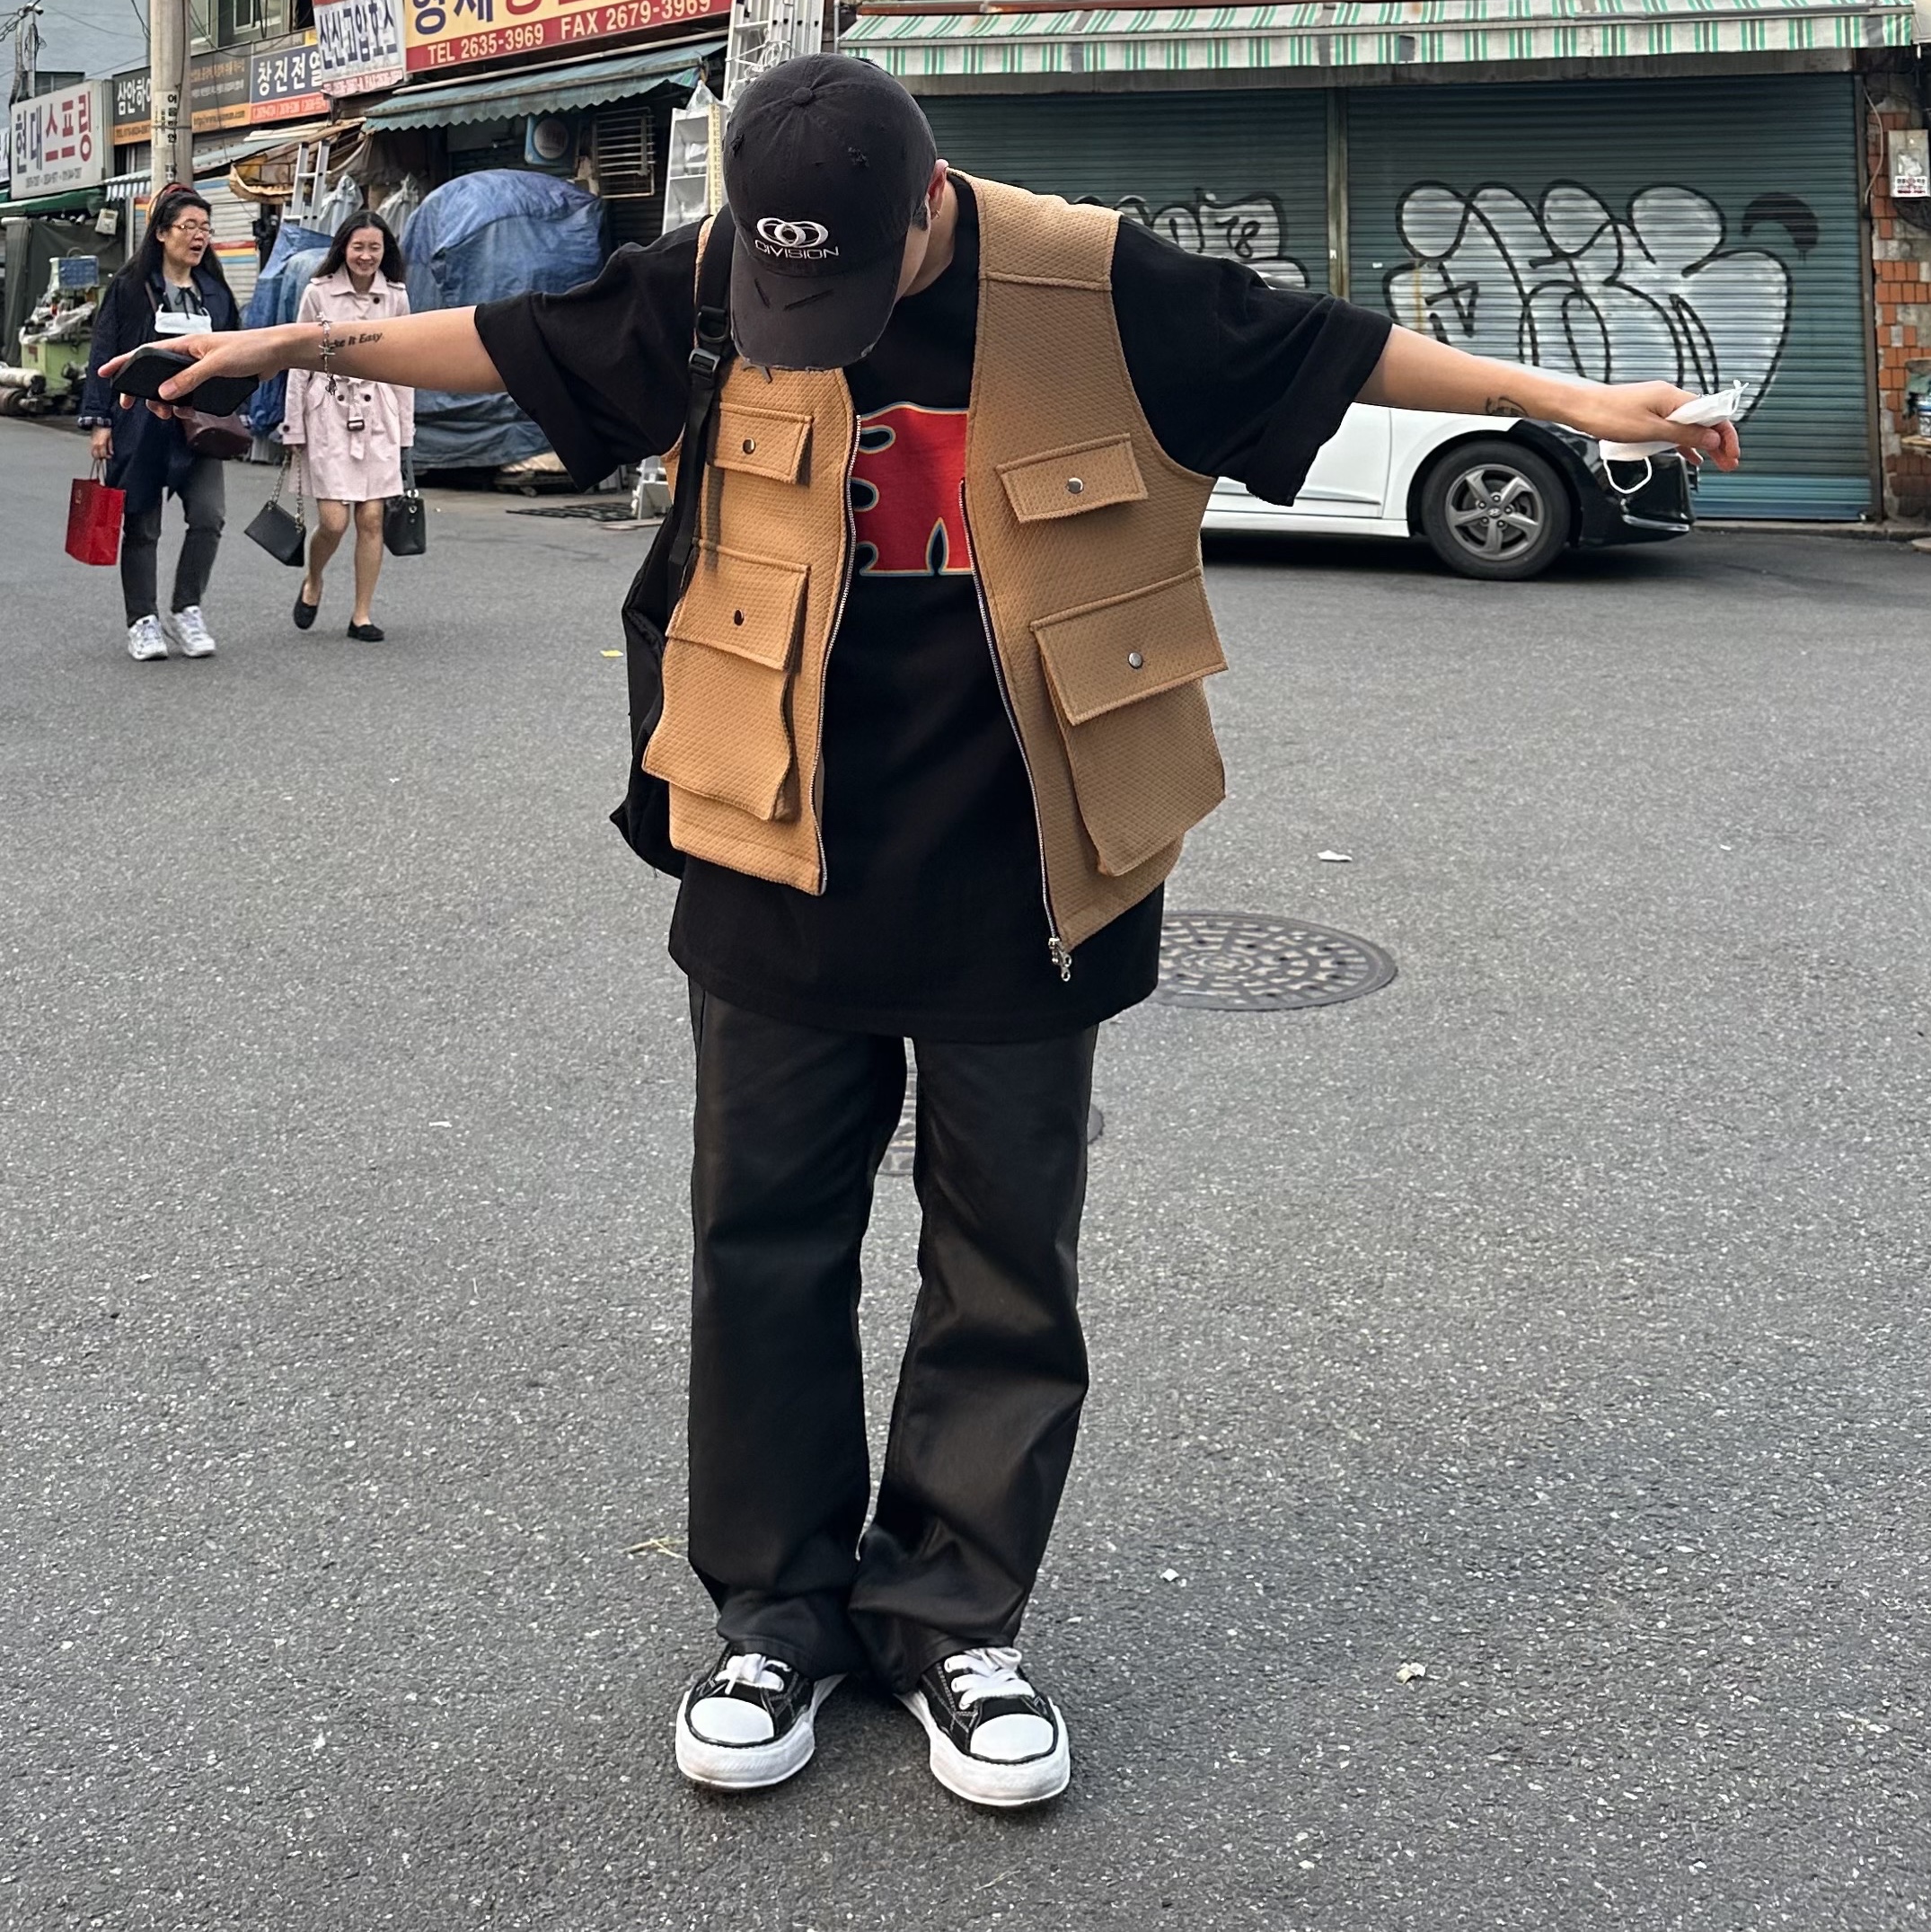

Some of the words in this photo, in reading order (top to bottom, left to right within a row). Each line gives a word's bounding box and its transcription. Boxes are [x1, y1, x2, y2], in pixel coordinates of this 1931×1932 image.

[428, 41, 455, 65] TEL
[461, 23, 544, 59] 2635-3969
[560, 11, 599, 40] FAX
[606, 0, 711, 31] 2679-3969
[15, 91, 92, 174] 현대스프링
